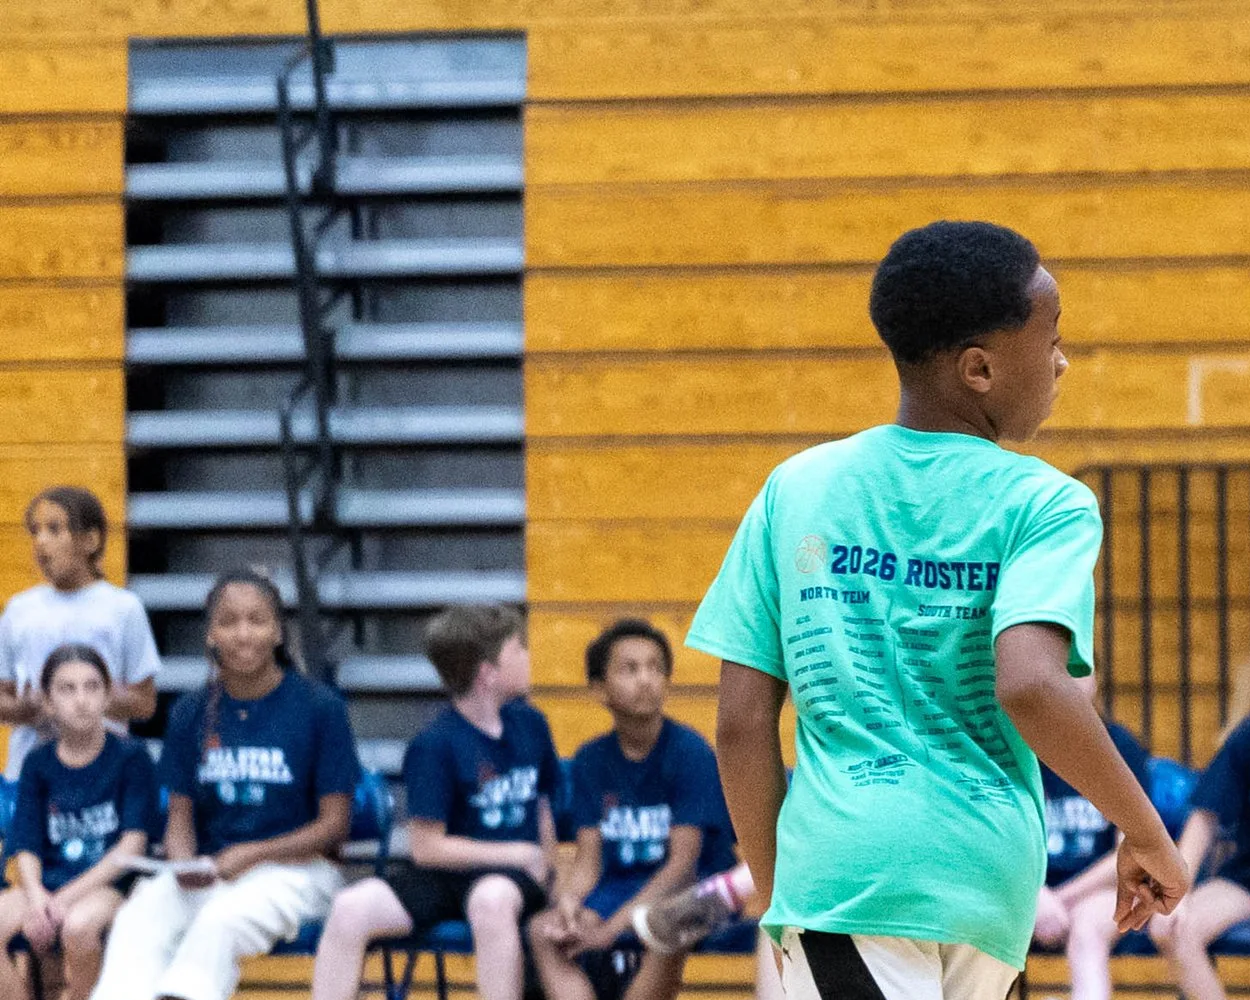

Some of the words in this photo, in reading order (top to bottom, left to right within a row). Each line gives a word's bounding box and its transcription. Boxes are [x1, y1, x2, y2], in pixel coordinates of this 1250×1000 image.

[831, 545, 897, 581] 2026
[904, 558, 1000, 591] ROSTER
[800, 586, 838, 602] NORTH
[842, 590, 870, 604] TEAM
[917, 604, 952, 618] SOUTH
[955, 606, 988, 620] TEAM
